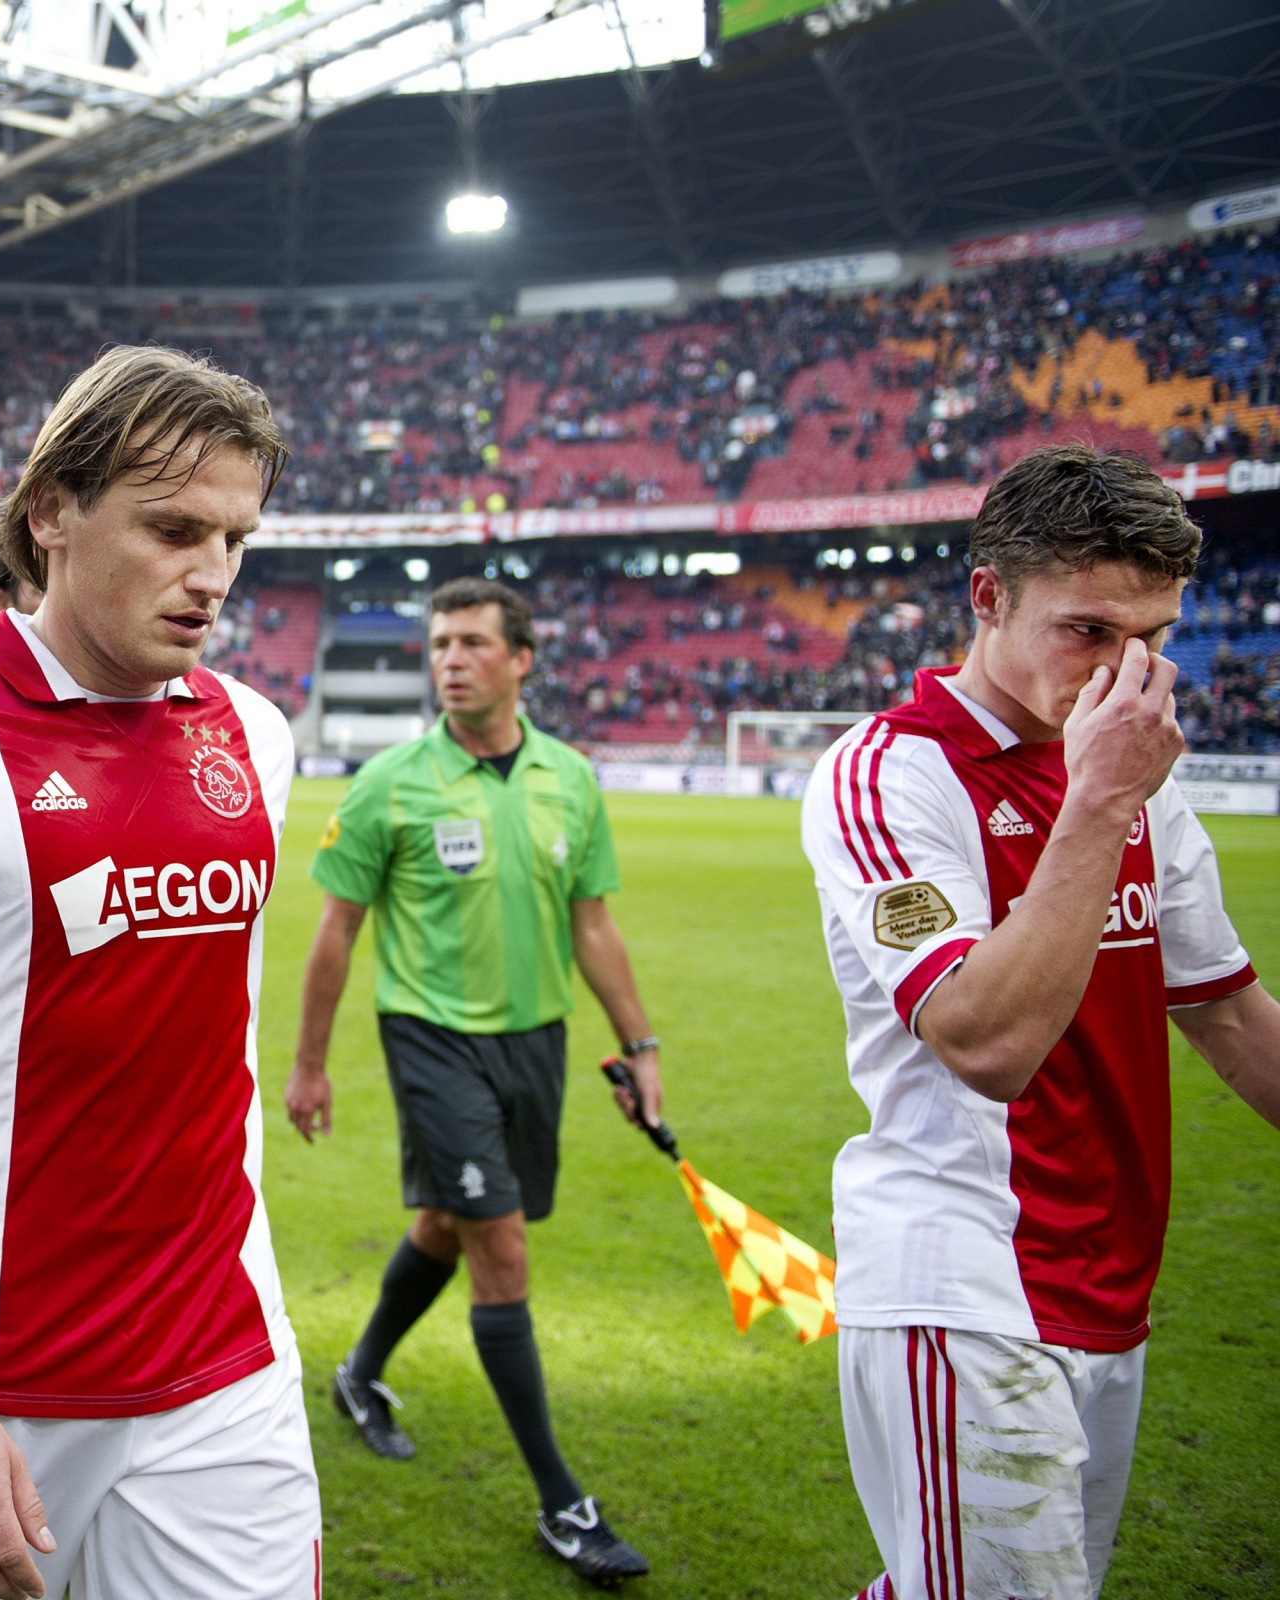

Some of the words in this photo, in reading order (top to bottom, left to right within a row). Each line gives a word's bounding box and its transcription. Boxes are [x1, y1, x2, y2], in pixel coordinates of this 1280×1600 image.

[188, 744, 212, 779] AJAX
[31, 795, 88, 811] adidas
[443, 841, 477, 853] FIFA
[97, 858, 268, 927] AEGON
[1103, 882, 1159, 934] GON
[889, 920, 916, 934] Meer
[918, 914, 938, 925] dan
[896, 923, 936, 940] Voetbal
